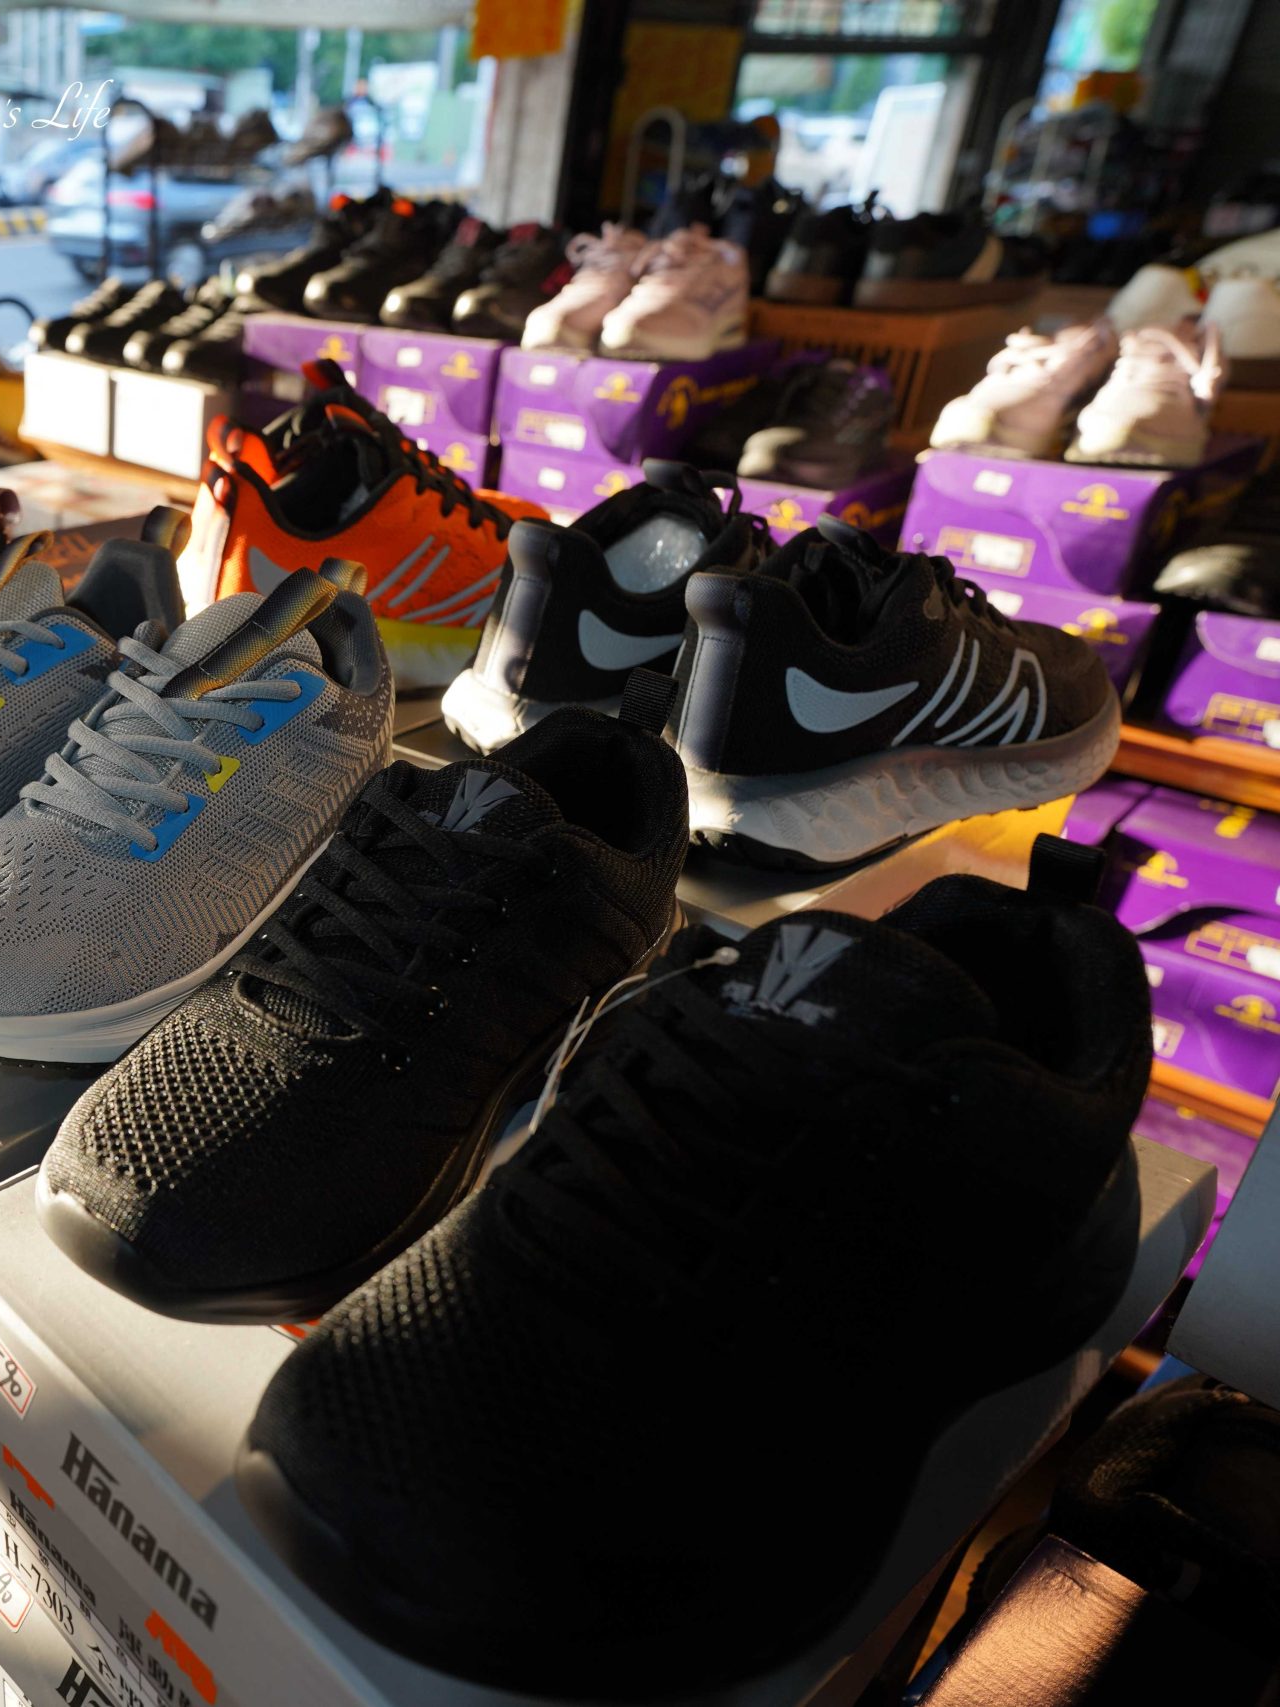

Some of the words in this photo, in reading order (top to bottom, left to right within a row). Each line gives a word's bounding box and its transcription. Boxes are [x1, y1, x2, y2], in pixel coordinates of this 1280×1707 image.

[3, 1530, 75, 1636] H-7303
[8, 1487, 96, 1607] Hanama
[60, 1429, 218, 1632] Hanama
